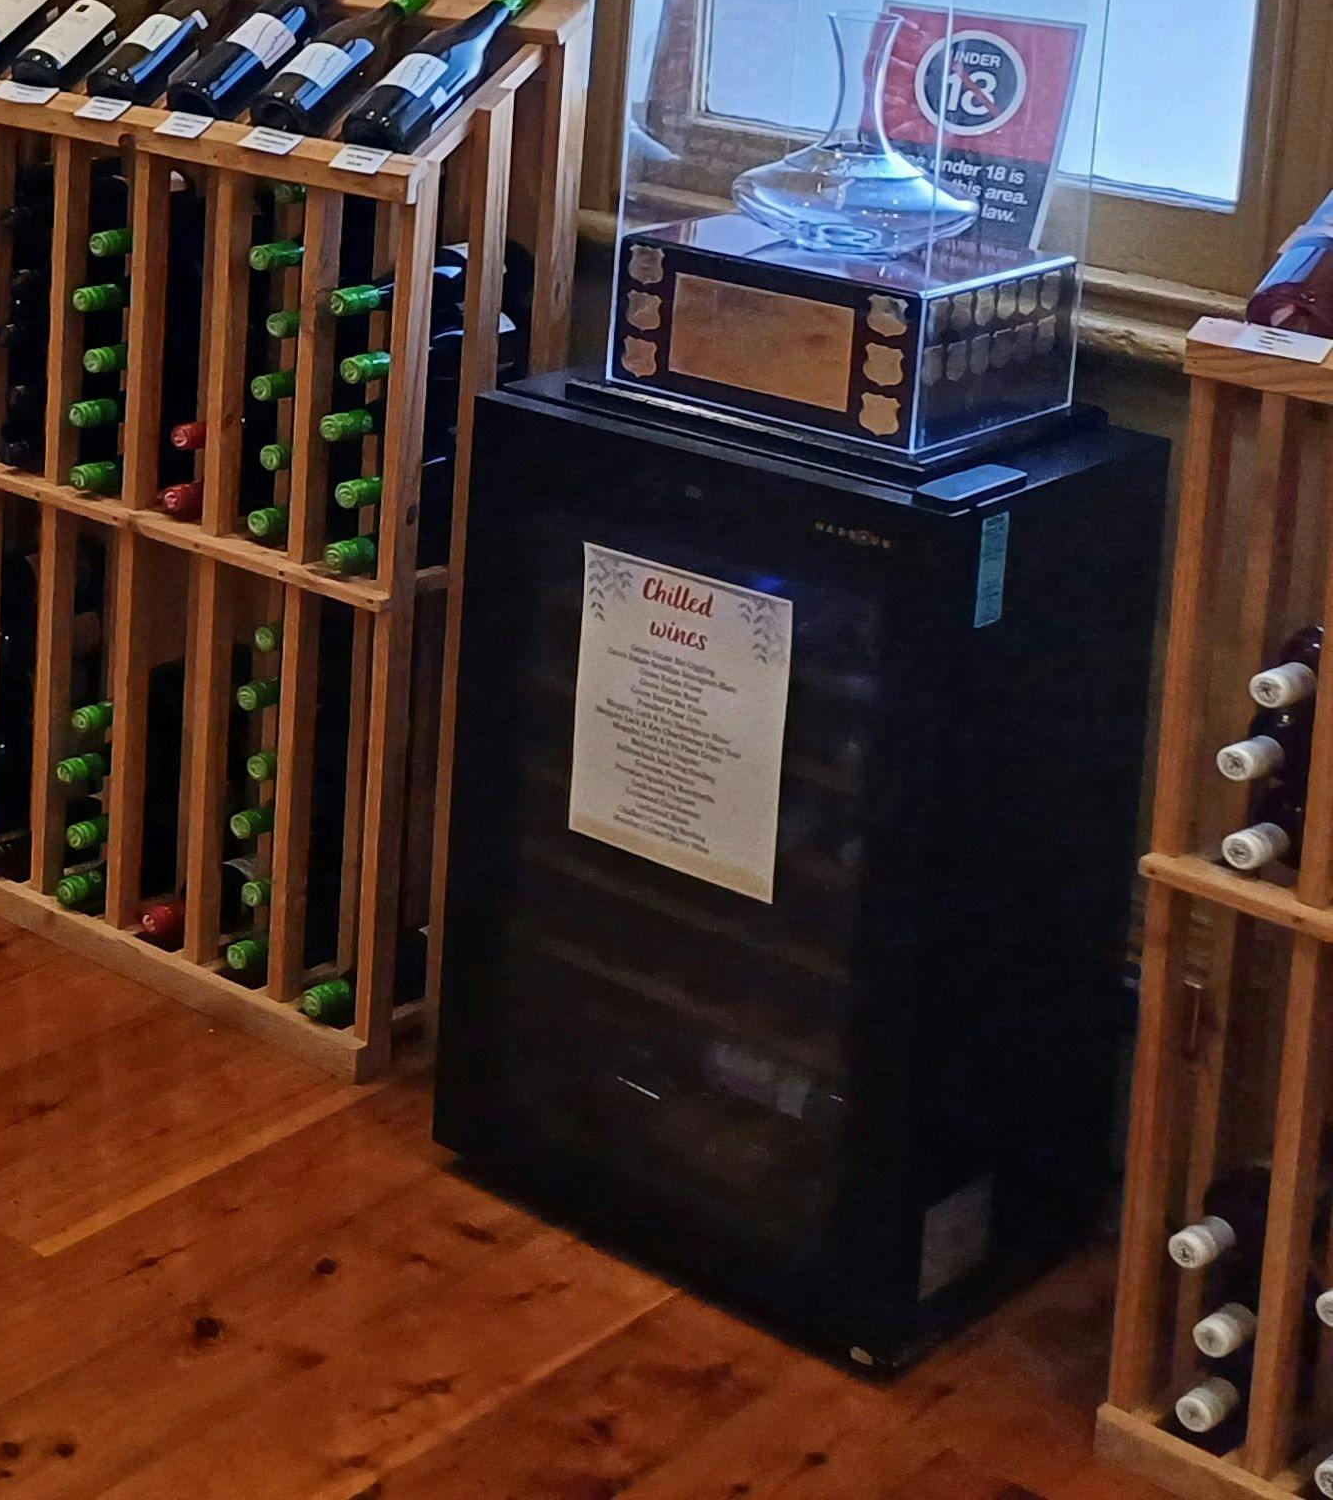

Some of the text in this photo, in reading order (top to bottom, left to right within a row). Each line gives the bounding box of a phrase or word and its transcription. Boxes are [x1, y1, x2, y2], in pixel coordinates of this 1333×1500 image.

[948, 71, 998, 115] 18
[986, 164, 1006, 181] 18
[1009, 168, 1025, 185] is
[984, 186, 1028, 205] area.
[981, 203, 1015, 222] law.
[643, 577, 714, 617] Chilled
[649, 619, 708, 650] wines
